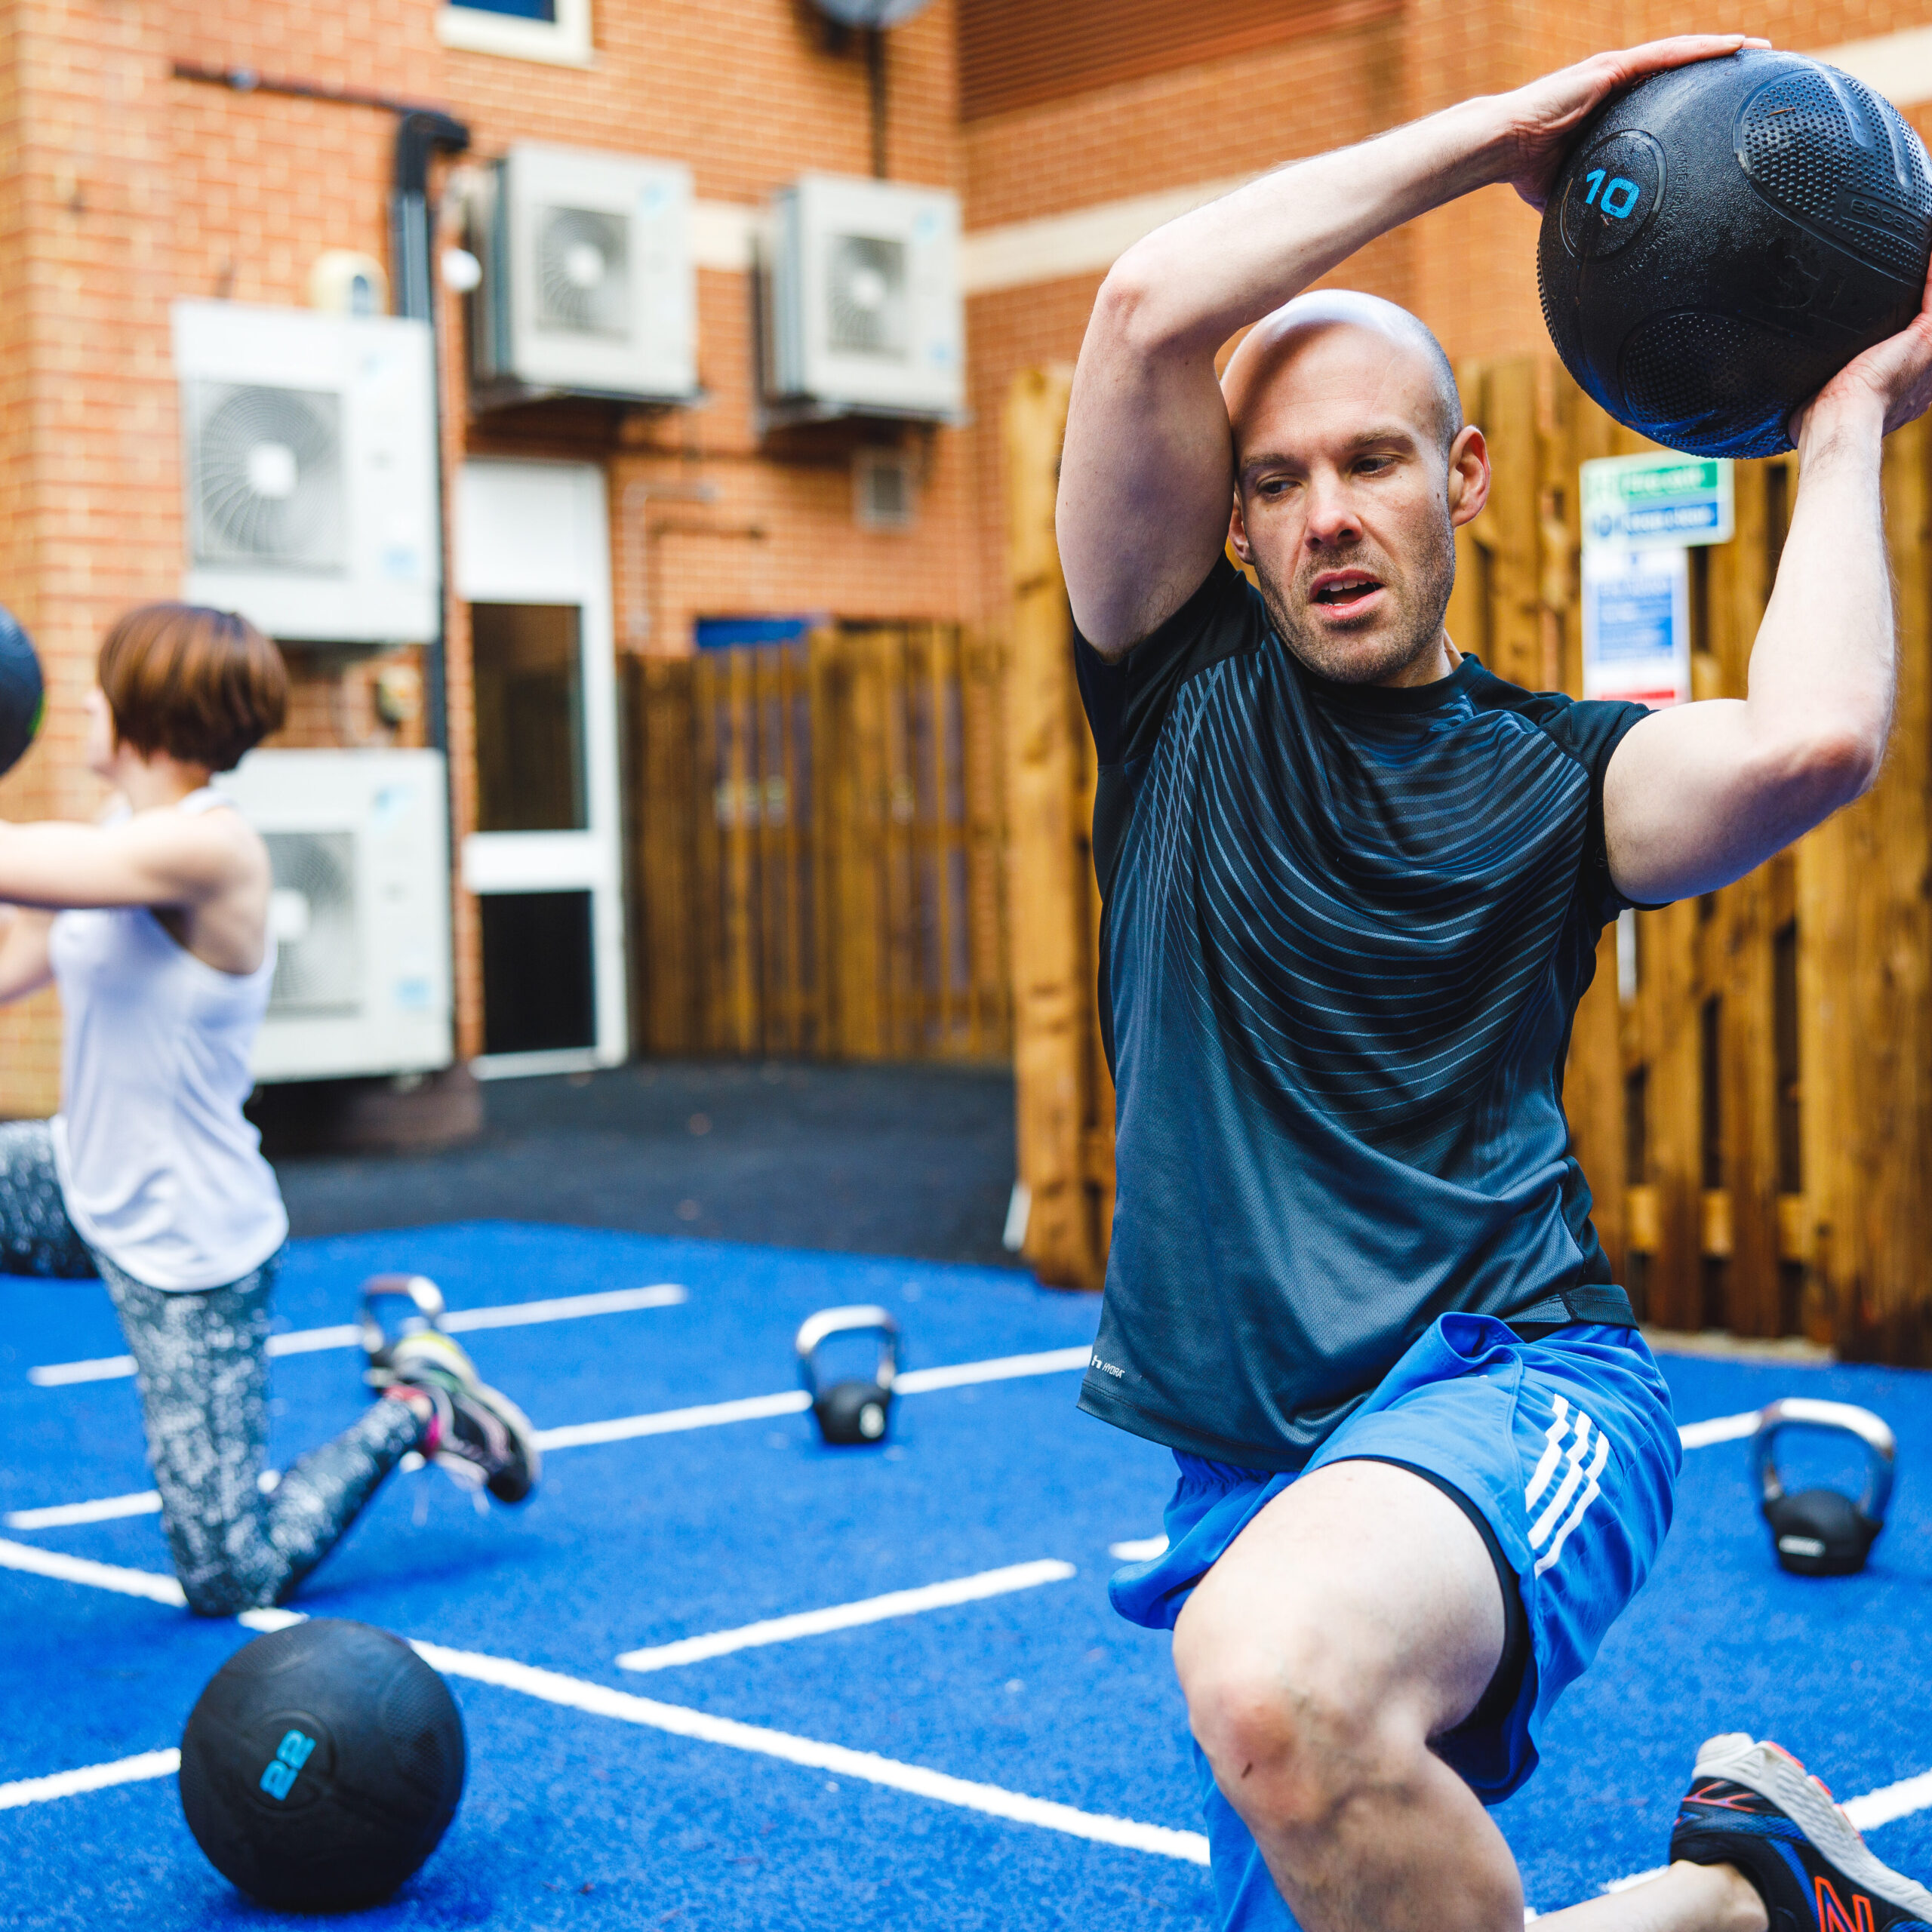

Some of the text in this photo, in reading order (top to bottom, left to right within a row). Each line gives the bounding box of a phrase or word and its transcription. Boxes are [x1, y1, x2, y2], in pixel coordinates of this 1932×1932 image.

[1586, 168, 1640, 219] 10
[1851, 198, 1924, 240] escape
[1102, 1362, 1123, 1378] HYDRA
[260, 1729, 316, 1801] 22
[1814, 1875, 1875, 1932] N
